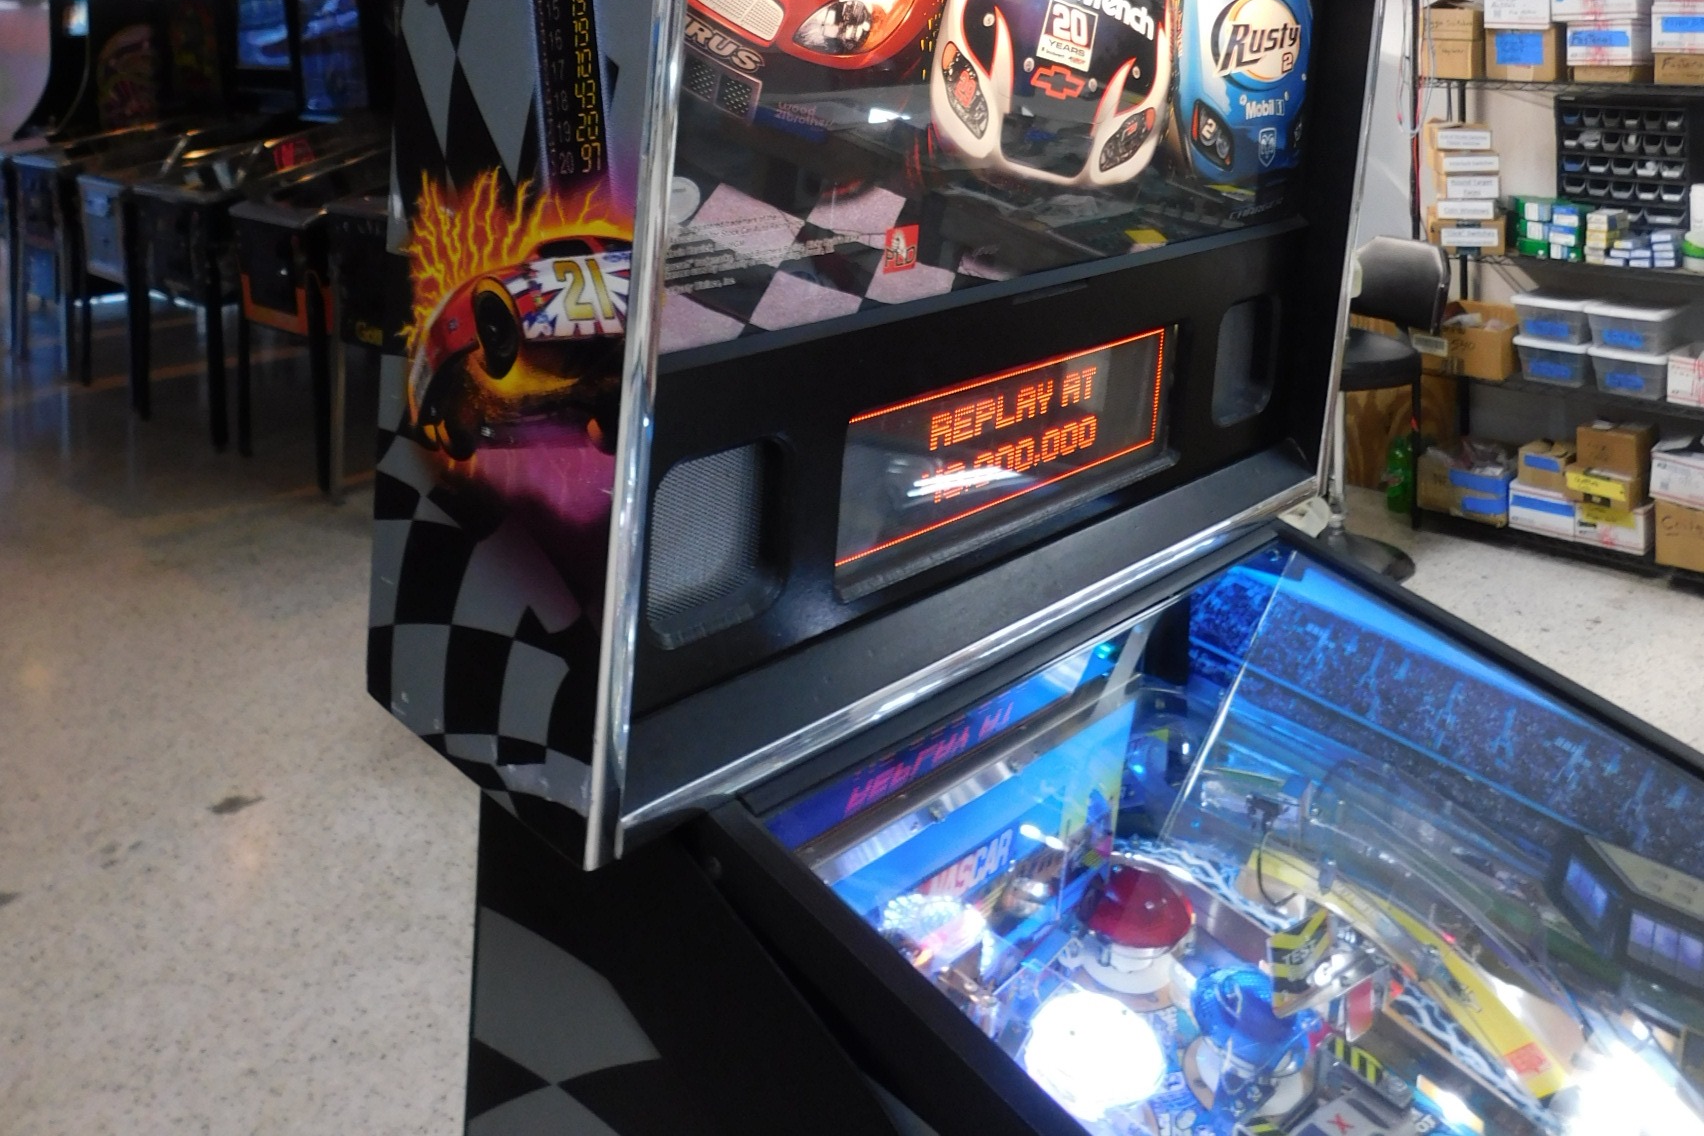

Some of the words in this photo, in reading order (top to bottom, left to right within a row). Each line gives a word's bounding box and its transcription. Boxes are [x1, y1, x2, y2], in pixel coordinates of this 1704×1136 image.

[684, 17, 761, 72] RUS
[1052, 3, 1089, 46] 20
[1049, 39, 1086, 58] YEARS
[1218, 23, 1300, 72] Rusty
[1281, 52, 1295, 74] 2
[1201, 118, 1216, 137] 2
[1245, 100, 1275, 120] Mobil
[554, 258, 615, 322] 21
[930, 380, 1054, 451] REPLAY
[1061, 366, 1098, 408] AT
